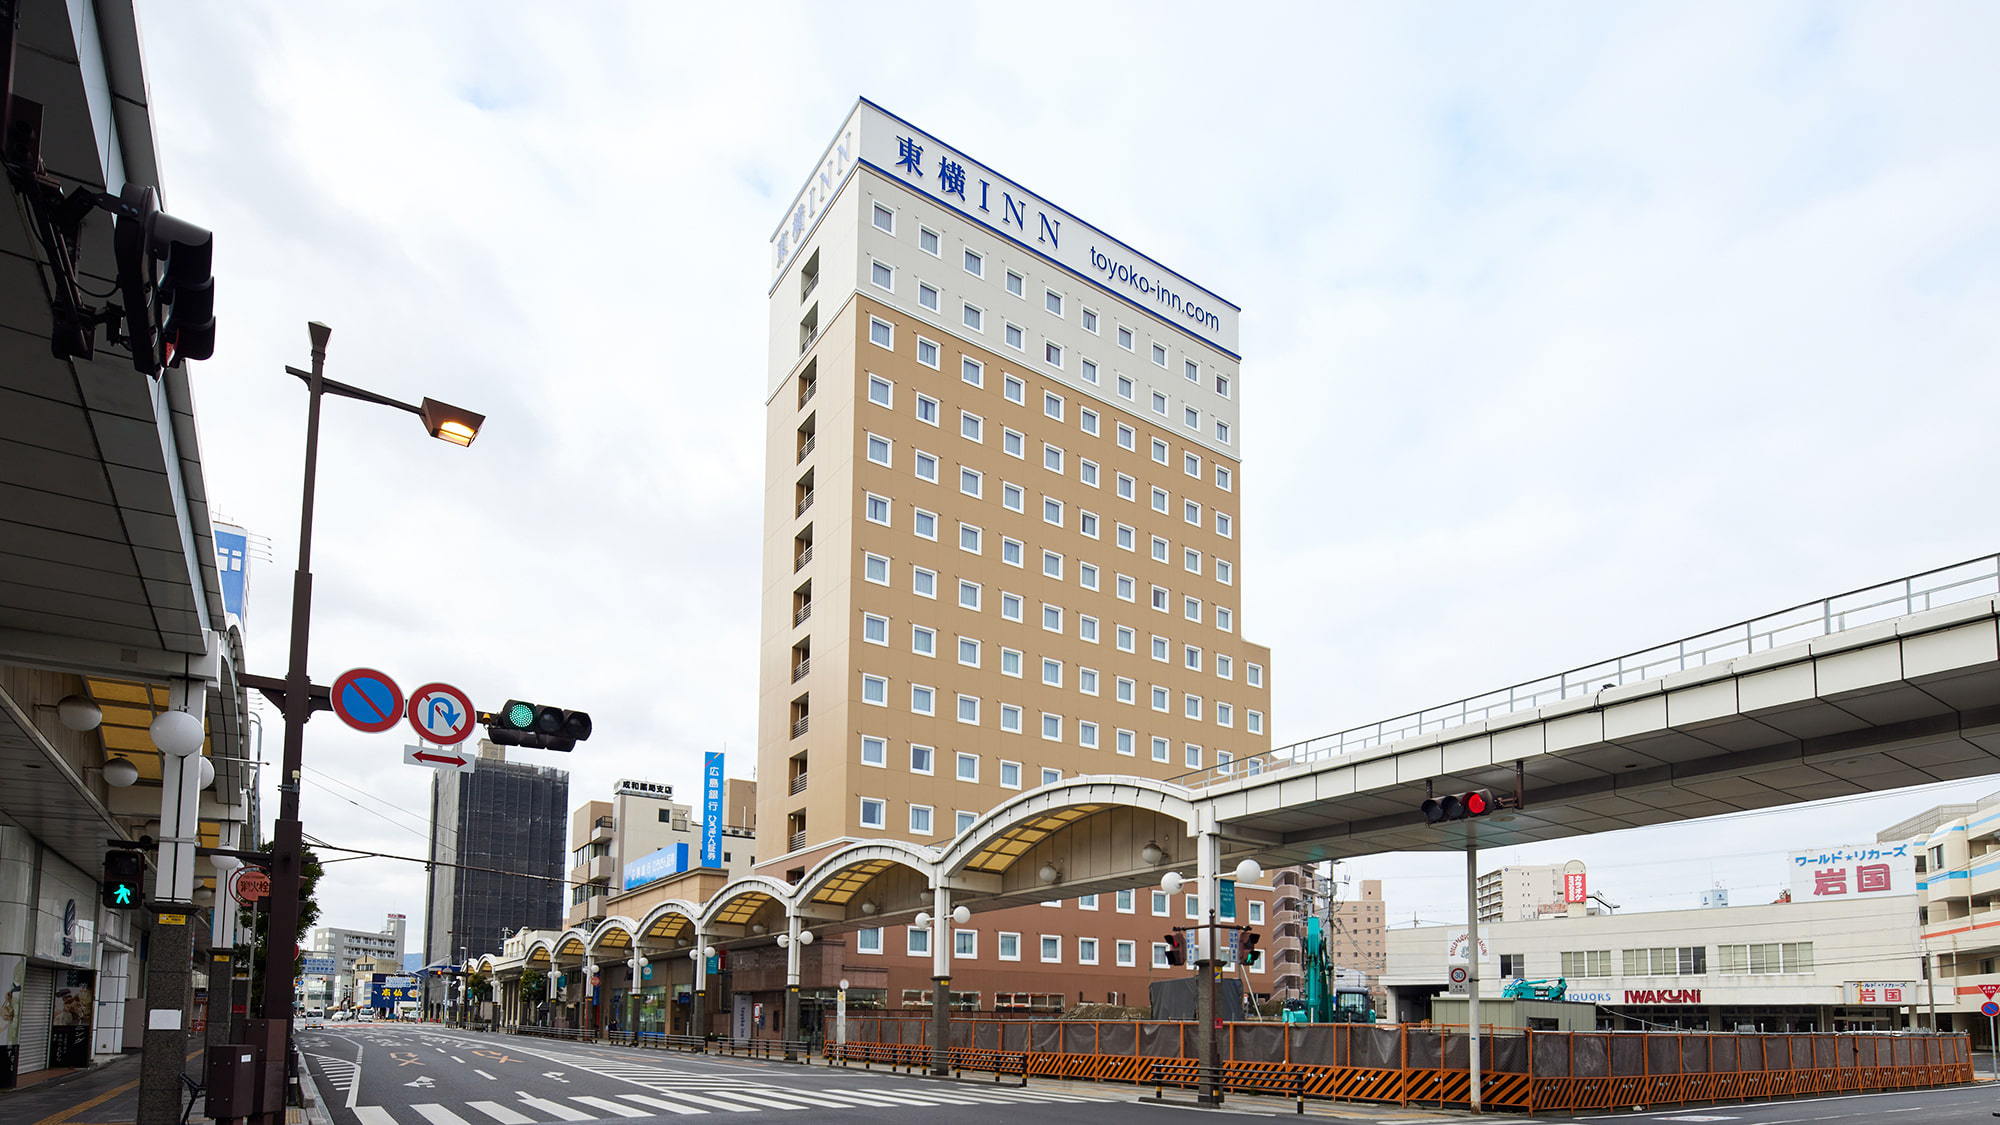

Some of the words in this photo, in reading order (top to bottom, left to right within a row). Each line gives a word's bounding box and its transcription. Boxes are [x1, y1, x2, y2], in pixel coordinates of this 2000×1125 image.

[1090, 246, 1220, 332] toyoko-inn.com
[240, 880, 271, 893] 消火栓
[1813, 863, 1891, 896] 岩国
[1574, 875, 1583, 901] カラオケ
[1454, 971, 1464, 979] 30
[1568, 992, 1611, 1001] IQUORS
[1624, 989, 1701, 1004] IWAKUNI
[1860, 988, 1902, 1002] 岩国
